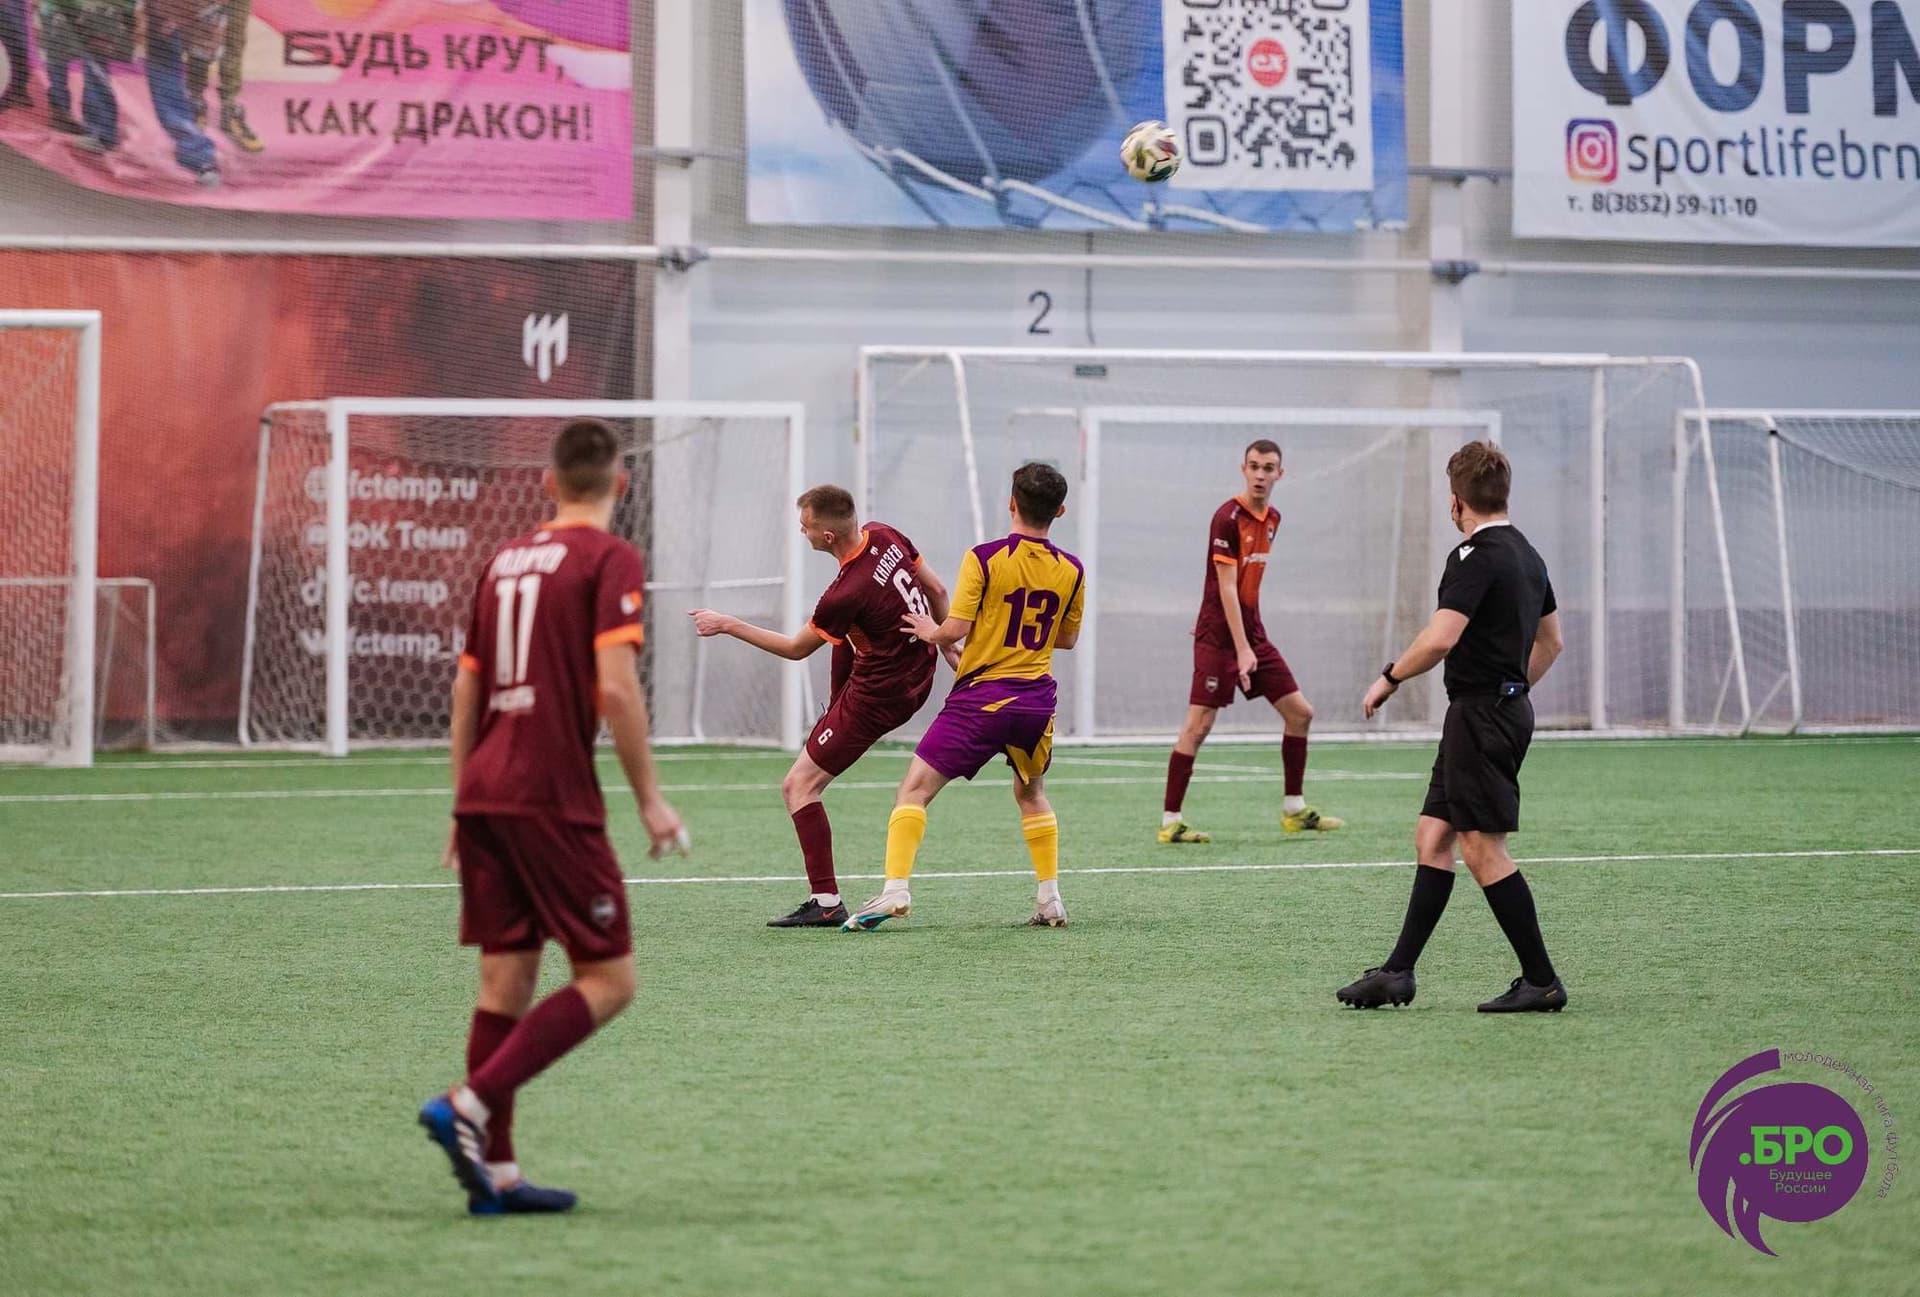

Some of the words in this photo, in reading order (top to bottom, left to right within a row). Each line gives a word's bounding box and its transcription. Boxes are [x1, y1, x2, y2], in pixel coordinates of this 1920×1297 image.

[283, 30, 430, 77] БУДЬ
[443, 33, 565, 80] КРУТ,
[285, 98, 378, 136] КАК
[394, 101, 593, 145] ДРАКОН!
[1592, 193, 1670, 217] 8(3852)
[1676, 196, 1757, 217] 59-11-10
[1028, 290, 1052, 335] 2
[348, 469, 478, 505] fctemp.ru
[348, 521, 390, 549] ФК
[395, 520, 467, 549] Темп
[873, 543, 904, 587] КНЯЗЕВ
[496, 573, 541, 686] 11
[1003, 587, 1060, 651] 13
[818, 728, 833, 745] 6
